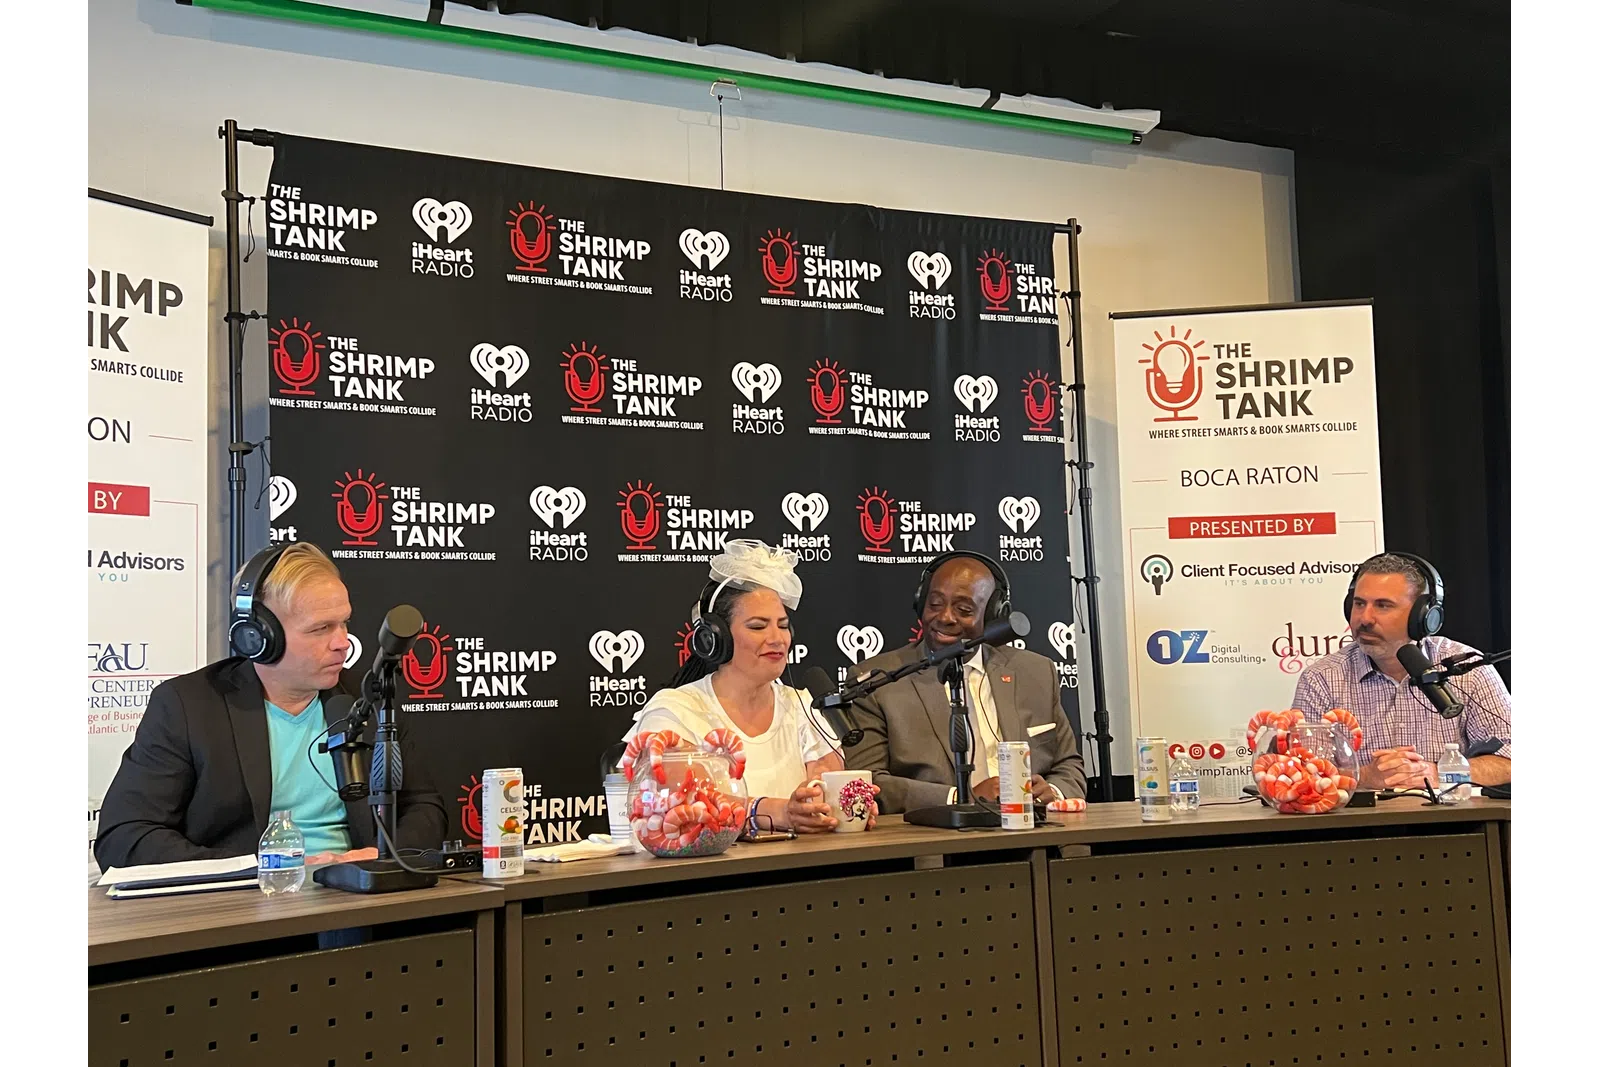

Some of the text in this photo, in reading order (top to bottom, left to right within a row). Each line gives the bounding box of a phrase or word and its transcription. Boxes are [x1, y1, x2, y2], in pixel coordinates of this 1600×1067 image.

[271, 184, 301, 199] THE
[270, 199, 377, 230] SHRIMP
[559, 219, 584, 233] THE
[270, 222, 345, 251] TANK
[412, 242, 472, 263] iHeart
[559, 233, 650, 260] SHRIMP
[802, 245, 825, 256] THE
[267, 248, 291, 259] MARTS
[300, 253, 320, 262] BOOK
[321, 255, 349, 264] SMARTS
[350, 258, 378, 268] COLLIDE
[413, 259, 473, 278] RADIO
[559, 255, 624, 280] TANK
[804, 257, 881, 281] SHRIMP
[1014, 263, 1035, 274] THE
[506, 274, 529, 283] WHERE
[530, 276, 552, 285] STREET
[554, 279, 578, 287] SMARTS
[604, 283, 627, 292] SMARTS
[628, 286, 652, 294] COLLIDE
[680, 270, 731, 288] iHeart
[681, 285, 732, 302] RADIO
[804, 278, 860, 299] TANK
[909, 291, 954, 306] iHeart
[910, 306, 955, 320] RADIO
[328, 337, 358, 350] THE
[1214, 343, 1252, 359] THE
[90, 358, 184, 383] SMARTS COLLIDE
[329, 351, 434, 379] SHRIMP
[611, 359, 637, 371] THE
[1216, 356, 1354, 388] SHRIMP
[613, 372, 702, 396] SHRIMP
[850, 372, 872, 385] THE
[329, 376, 404, 401] TANK
[851, 385, 928, 408] SHRIMP
[471, 388, 531, 407] iHeart
[613, 394, 676, 416] TANK
[1216, 390, 1314, 420] TANK
[269, 398, 294, 407] WHERE
[296, 400, 321, 408] STREET
[322, 401, 351, 410] SMARTS
[359, 404, 378, 412] BOOK
[380, 405, 407, 414] SMARTS
[408, 407, 436, 415] COLLIDE
[472, 406, 532, 422] RADIO
[733, 404, 783, 420] iHeart
[585, 417, 606, 425] STREET
[608, 418, 632, 426] SMARTS
[851, 405, 906, 428] TANK
[955, 414, 999, 429] iHeart
[733, 420, 784, 434] RADIO
[846, 428, 867, 436] SMARTS
[956, 429, 1000, 442] RADIO
[1149, 422, 1358, 439] WHERE STREET SMARTS & BOOK SMARTS COLLIDE
[1181, 466, 1318, 487] BOCA RATON
[94, 490, 122, 510] BY
[391, 487, 420, 499] THE
[666, 495, 691, 507] THE
[392, 501, 495, 524] SHRIMP
[899, 502, 921, 512] THE
[667, 508, 754, 529] SHRIMP
[900, 513, 976, 532] SHRIMP
[1190, 518, 1315, 536] PRESENTED BY
[391, 525, 464, 547] TANK
[530, 530, 587, 546] iHeart
[667, 531, 728, 550] TANK
[783, 533, 830, 547] iHeart
[900, 534, 954, 552] TANK
[1000, 535, 1042, 548] iHeart
[97, 550, 184, 570] Advisors
[384, 551, 412, 559] SMARTS
[441, 552, 468, 560] SMARTS
[530, 547, 588, 561] RADIO
[1000, 549, 1043, 561] RADIO
[98, 574, 128, 582] YOU
[1181, 561, 1360, 578] Client Focused Advisor
[1254, 578, 1292, 586] ABOUT
[455, 638, 484, 650] THE
[1212, 645, 1240, 655] Digital
[456, 651, 556, 673] SHRIMP
[92, 679, 154, 693] CENTER
[456, 675, 527, 697] TANK
[590, 676, 646, 691] iHeart
[402, 704, 424, 712] WHERE
[425, 703, 449, 711] STREET
[450, 702, 478, 710] SMARTS
[590, 691, 648, 706] RADIO
[102, 711, 111, 721] of
[523, 784, 542, 798] HE
[523, 820, 582, 844] ANK
